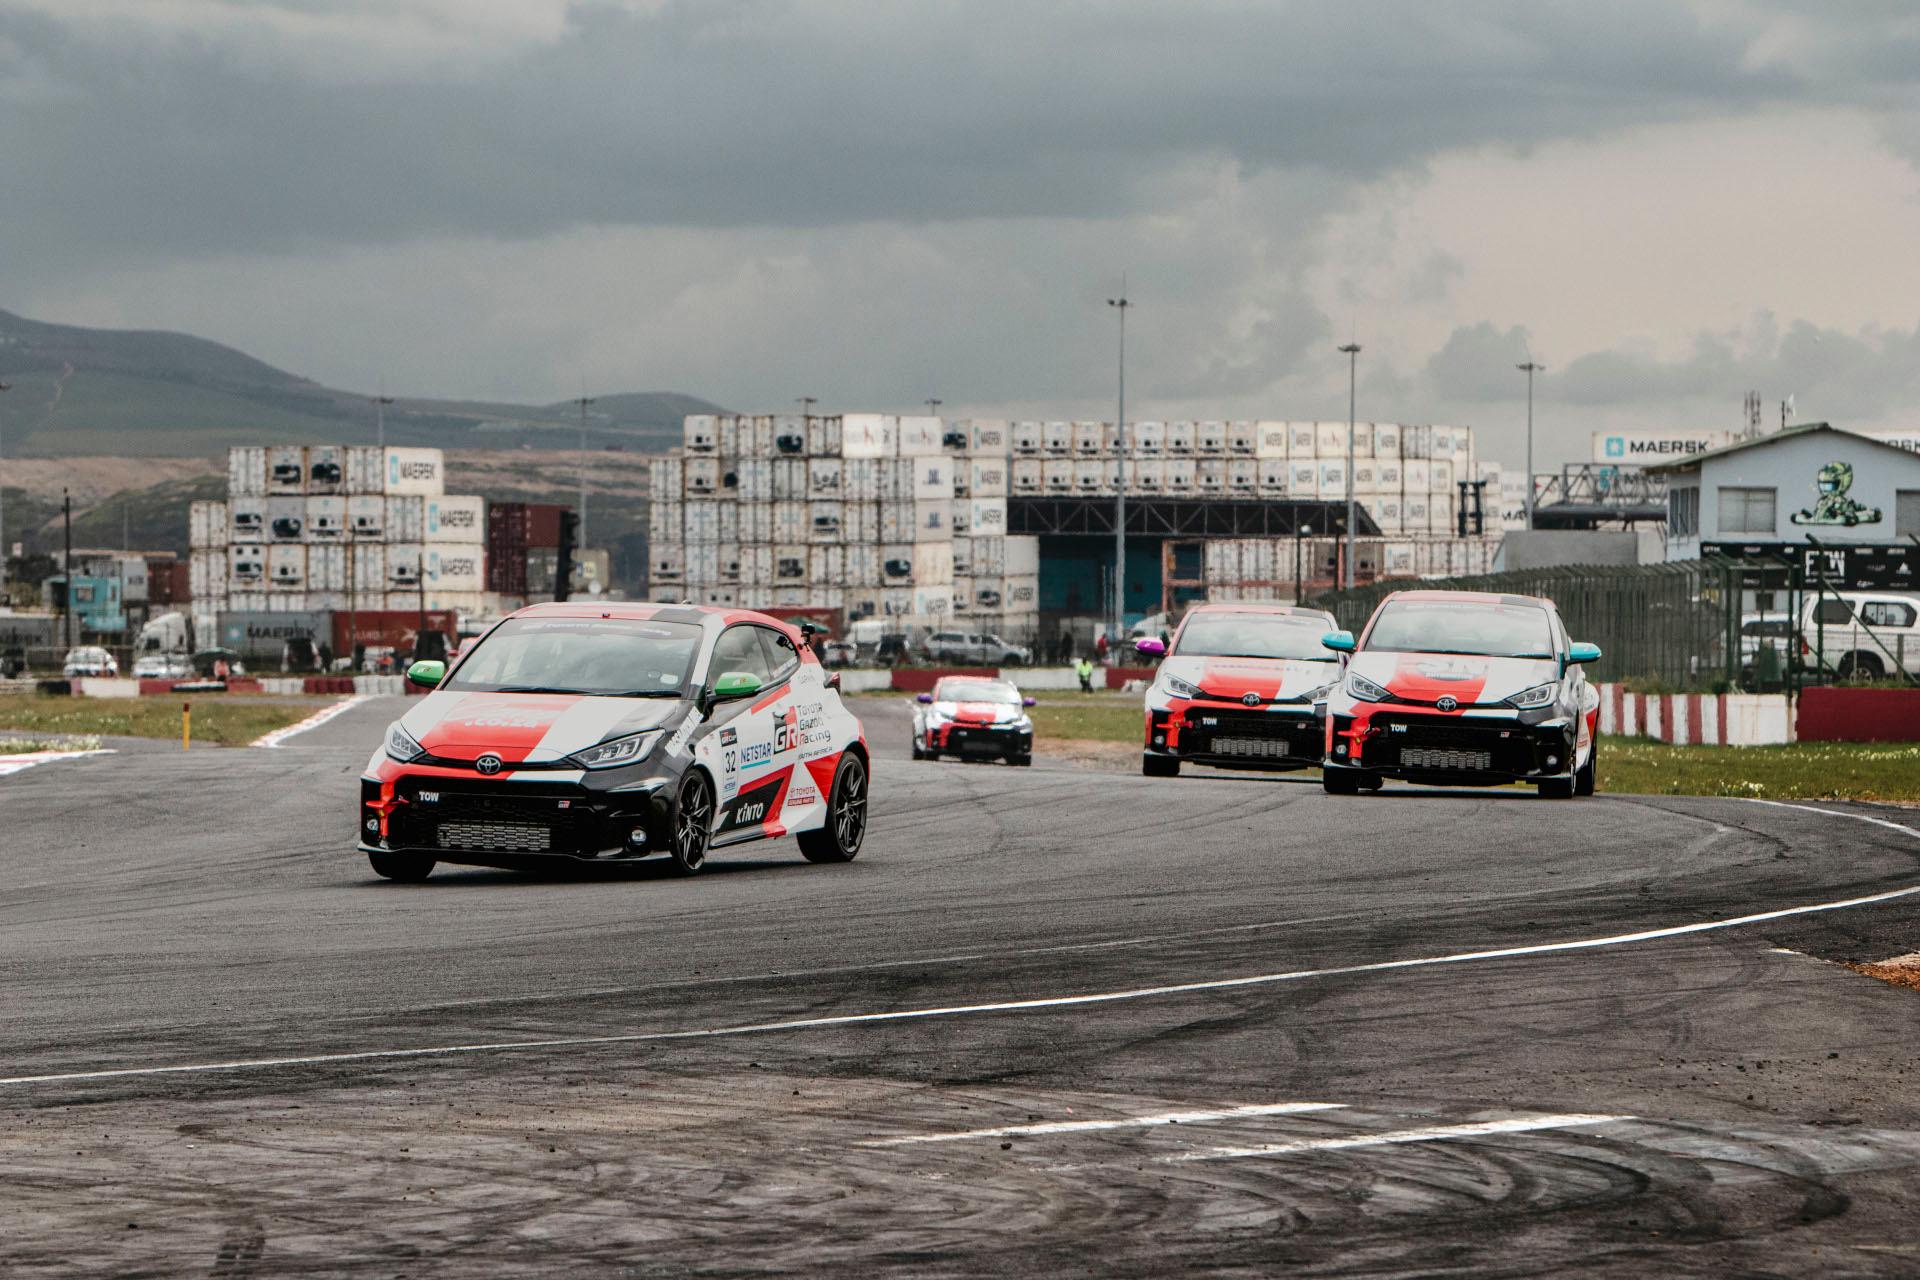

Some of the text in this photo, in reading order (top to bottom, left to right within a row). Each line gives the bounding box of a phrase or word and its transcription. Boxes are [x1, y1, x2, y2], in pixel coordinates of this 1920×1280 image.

[1630, 440, 1709, 454] MAERSK
[402, 461, 436, 480] MAERSK
[440, 510, 476, 527] MAERSK
[248, 625, 316, 639] MAERSK
[797, 702, 823, 717] TOYOTA
[1391, 724, 1407, 732] TOW
[775, 723, 797, 752] GR
[800, 730, 831, 745] Racing
[741, 743, 772, 763] NETSTAR
[725, 751, 736, 774] 32
[419, 791, 439, 801] TOW
[796, 786, 815, 796] TOYOTA
